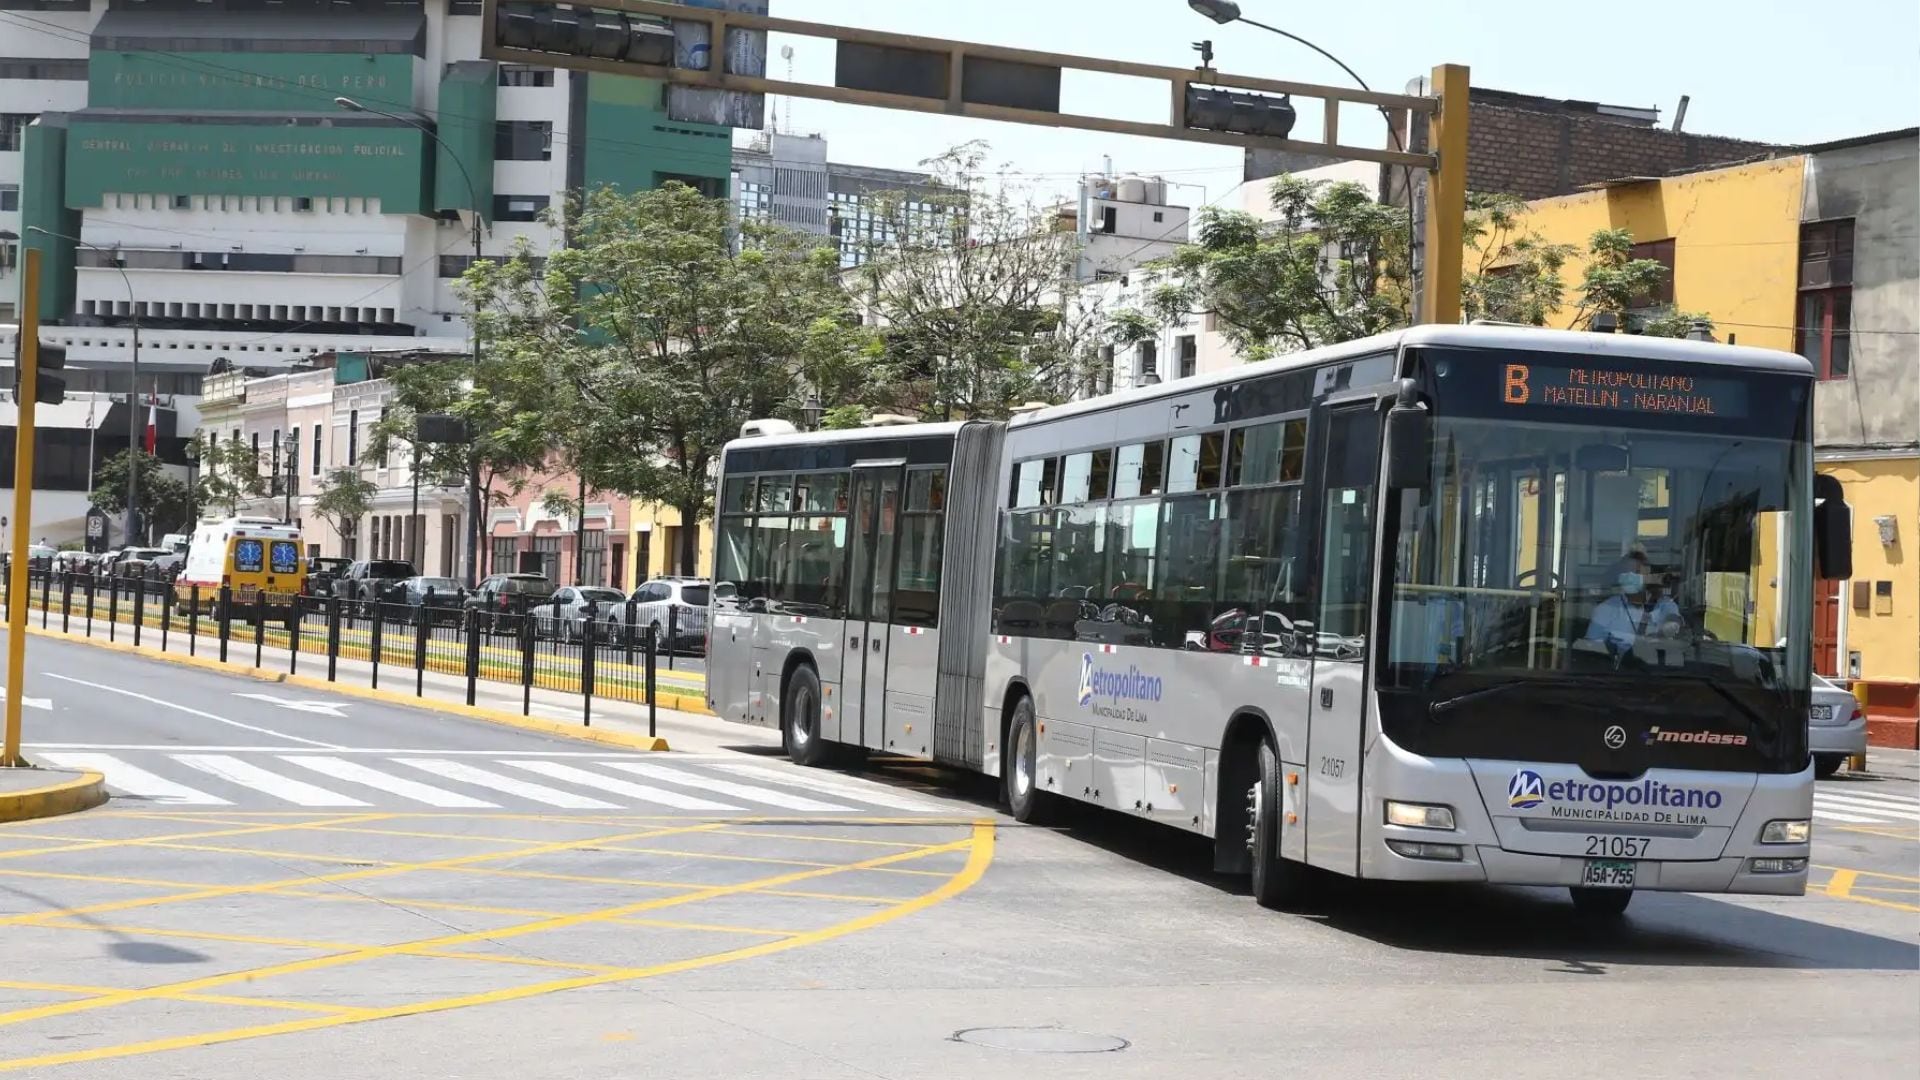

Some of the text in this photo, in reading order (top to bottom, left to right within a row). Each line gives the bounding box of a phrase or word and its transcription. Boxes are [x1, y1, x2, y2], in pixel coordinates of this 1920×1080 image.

[353, 143, 405, 157] POLICIAL
[1504, 364, 1529, 404] B
[1569, 369, 1693, 391] METROPOLITANO
[1544, 387, 1618, 407] MATELLINI
[1635, 394, 1714, 413] NARANJAL
[1079, 653, 1162, 706] Metropolitano
[1656, 730, 1749, 746] modasa
[1321, 757, 1345, 778] 21057
[1509, 769, 1722, 809] Metropolitano
[1585, 834, 1651, 858] 21057
